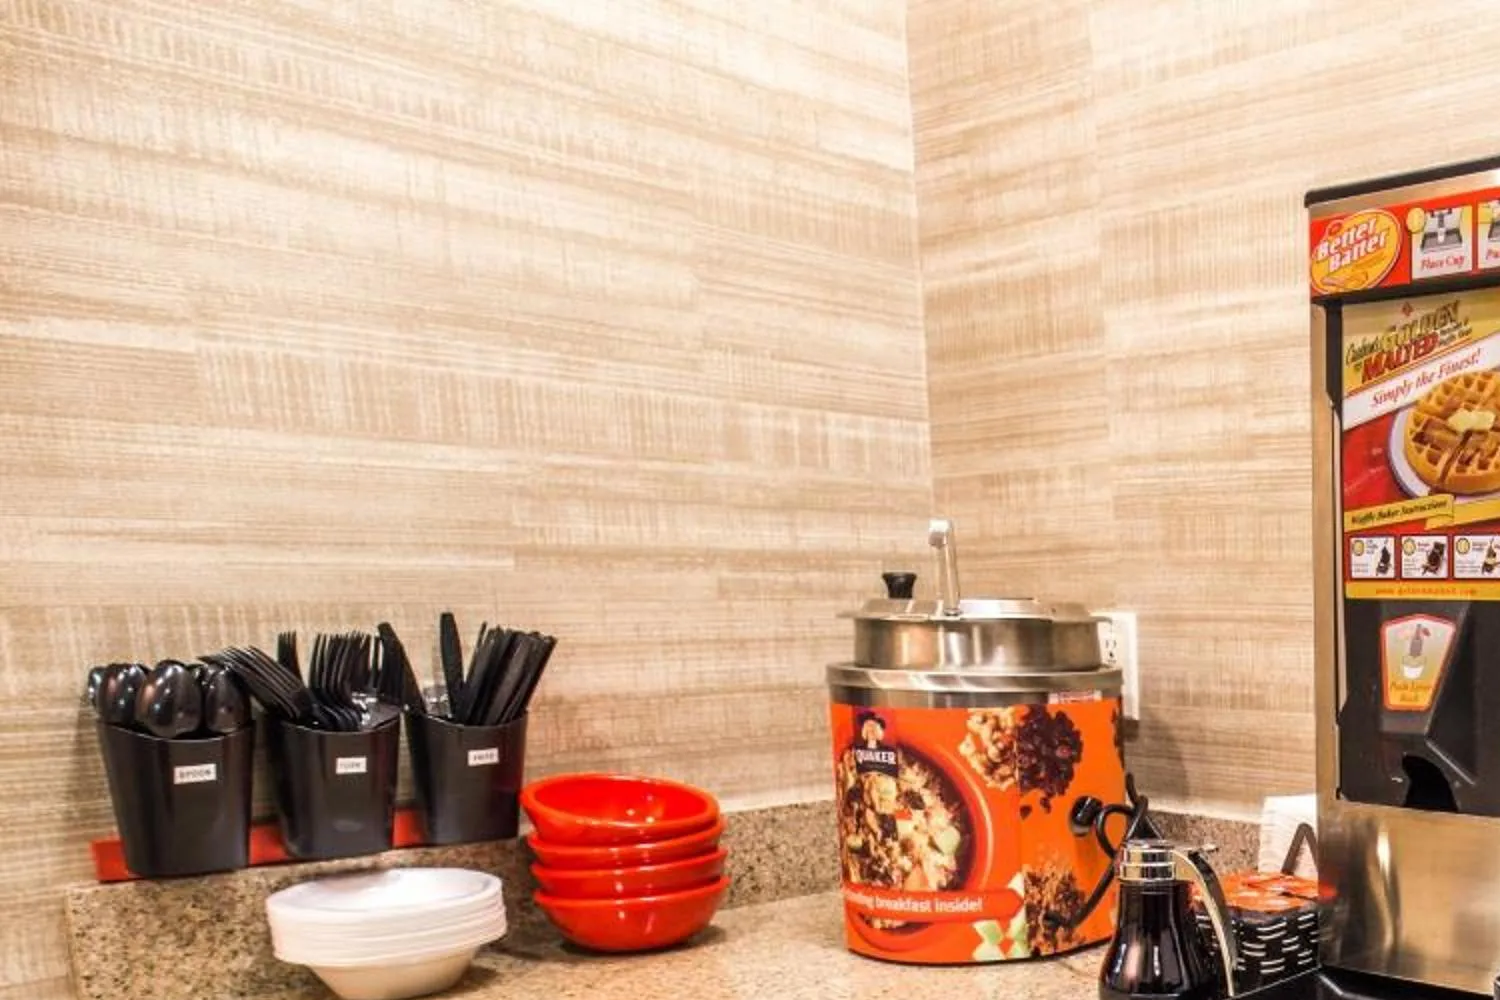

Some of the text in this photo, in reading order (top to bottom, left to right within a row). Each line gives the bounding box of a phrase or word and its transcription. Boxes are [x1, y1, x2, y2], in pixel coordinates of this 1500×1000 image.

[1316, 218, 1376, 261] Better
[1328, 230, 1387, 273] Batter
[1361, 331, 1440, 384] MALTED
[1371, 347, 1483, 408] Simply the Finest!
[855, 749, 897, 765] QUAKER
[874, 895, 932, 913] breakfast
[934, 897, 983, 913] inside!
